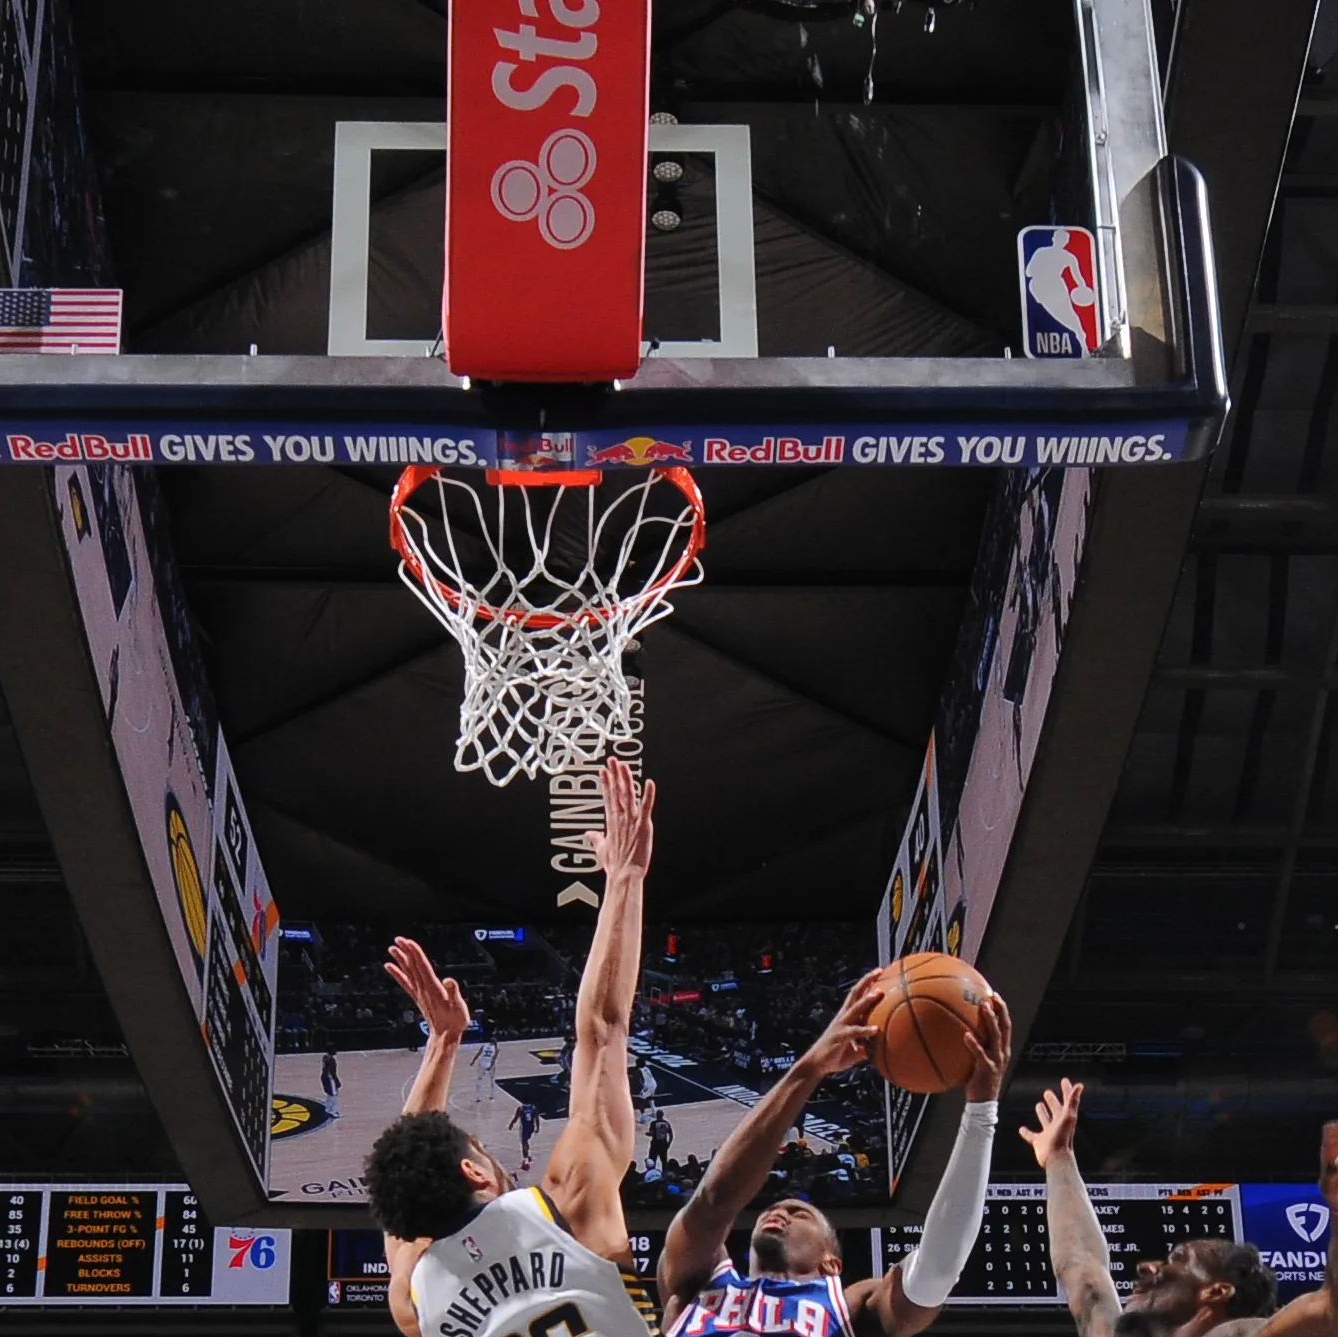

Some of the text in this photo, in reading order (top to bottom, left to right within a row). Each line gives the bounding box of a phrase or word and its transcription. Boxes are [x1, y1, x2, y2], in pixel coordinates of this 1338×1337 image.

[1036, 332, 1073, 355] NBA
[162, 434, 255, 462] GIVES
[262, 435, 334, 462] YOU
[344, 436, 488, 467] WIIINGS.
[852, 436, 945, 464] GIVES
[957, 436, 1025, 463] YOU
[1036, 435, 1172, 463] WIIINGS.
[1016, 1189, 1031, 1197] AST
[9, 1196, 128, 1205] 40 FIELD GOAL
[8, 1210, 197, 1219] 85 FREE THROW 84
[1094, 1206, 1174, 1215] AXEY 15
[7, 1225, 196, 1234] 35 3-POINT FG 45
[1163, 1225, 1175, 1233] 10
[14, 1239, 30, 1250] (4)
[57, 1239, 114, 1248] REBOUNDS
[117, 1239, 146, 1250] (OFF)
[173, 1239, 187, 1249] 17
[189, 1239, 204, 1250] (1)
[629, 1237, 651, 1251] 18
[887, 1243, 901, 1252] 26
[229, 1235, 276, 1269] 76
[6, 1254, 193, 1263] 10 ASSISTS 11
[1259, 1251, 1327, 1268] FANDU
[7, 1269, 15, 1278] 2
[78, 1269, 121, 1278] BLOCKS
[6, 1283, 190, 1293] 6 TURNOVERS 6
[346, 1294, 384, 1302] TORONTO
